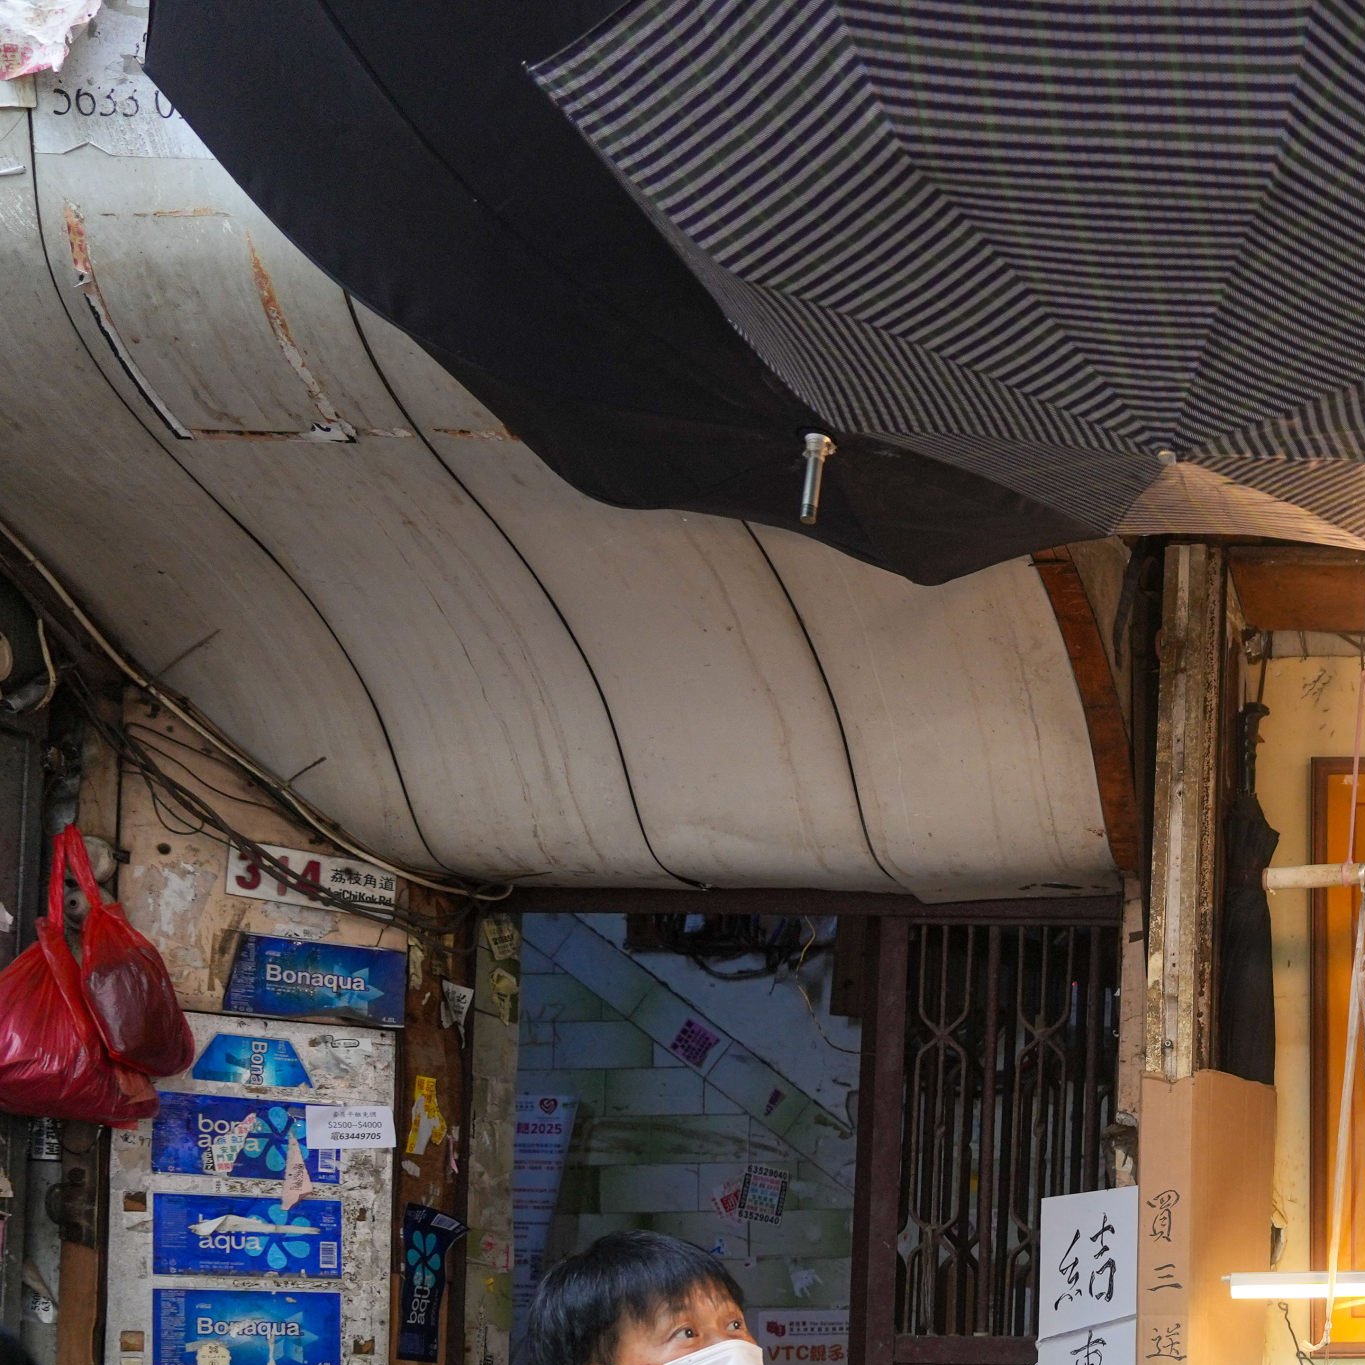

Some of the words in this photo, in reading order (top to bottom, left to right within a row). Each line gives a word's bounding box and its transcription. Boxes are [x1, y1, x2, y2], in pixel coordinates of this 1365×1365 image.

[330, 868, 396, 892] 荔枝角道
[265, 963, 367, 993] Bonaqua
[199, 1234, 262, 1254] aqua
[196, 1316, 300, 1339] Bonaqua
